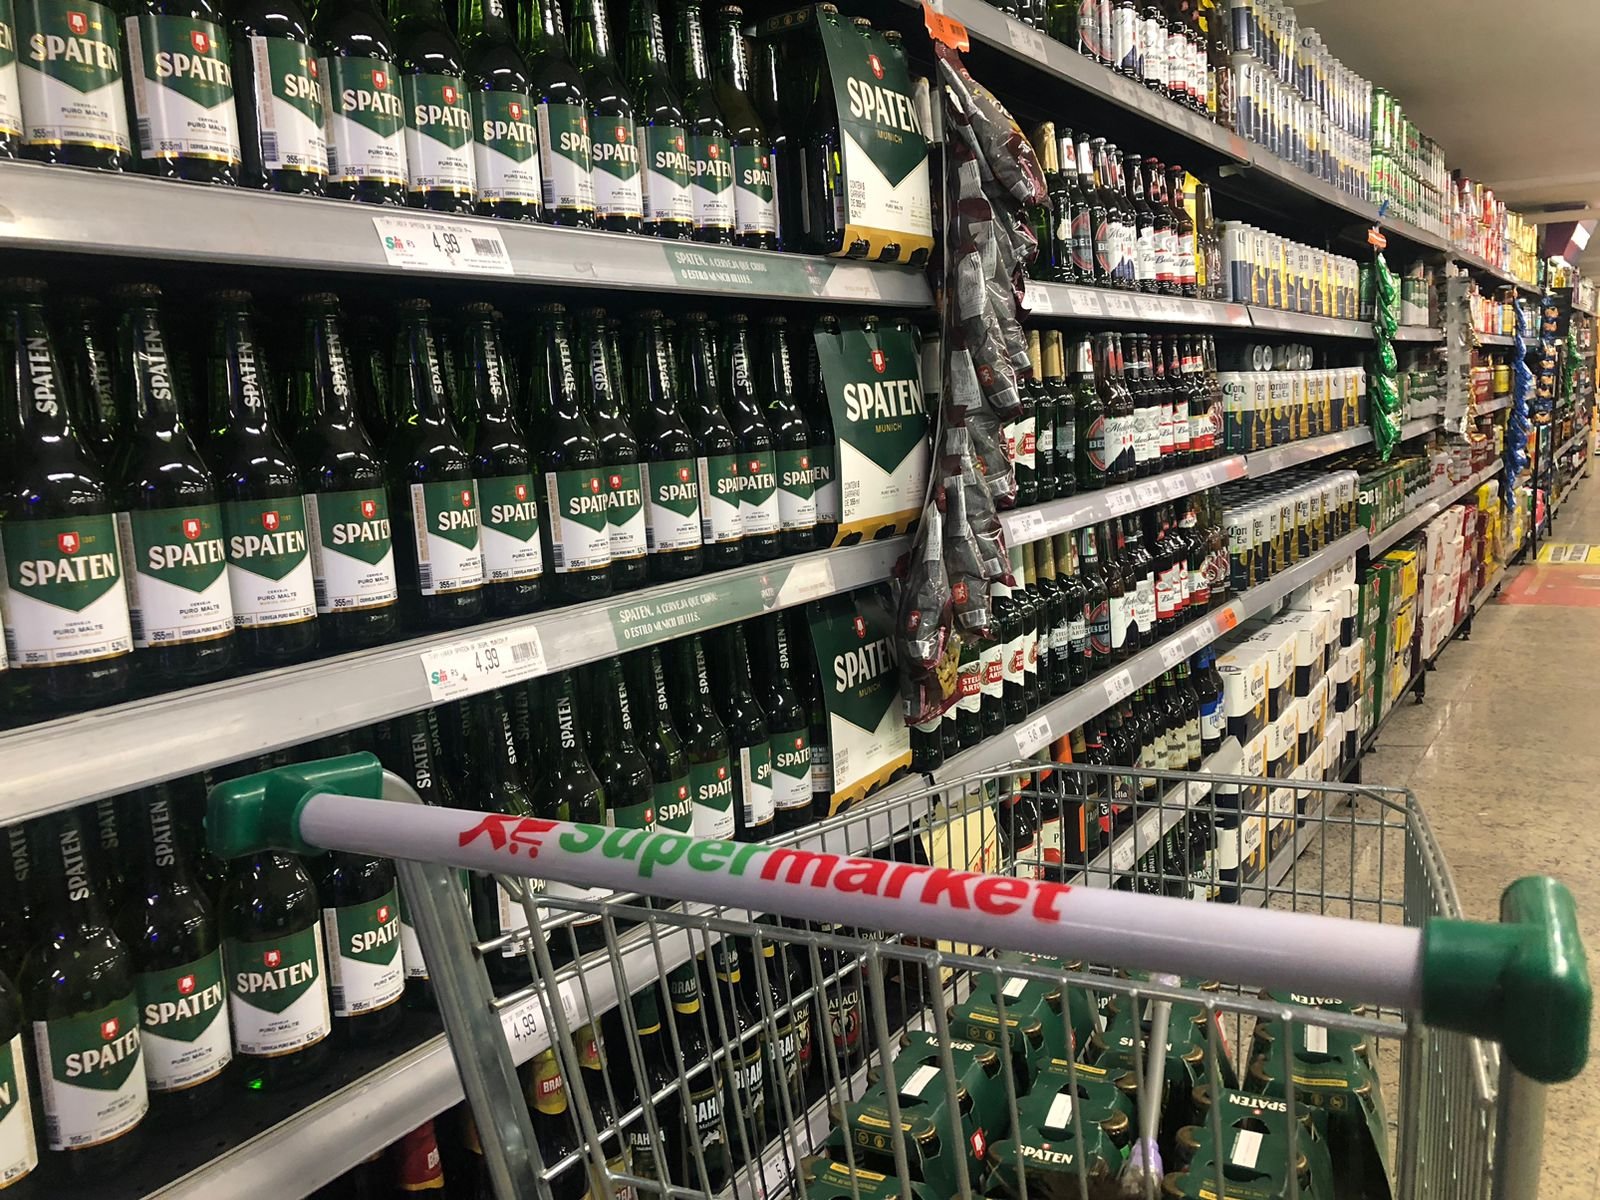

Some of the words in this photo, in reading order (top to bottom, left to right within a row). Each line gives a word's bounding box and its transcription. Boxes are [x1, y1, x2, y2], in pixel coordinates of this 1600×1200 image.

[30, 33, 118, 73] SPATEN
[154, 52, 233, 88] SPATEN
[284, 73, 321, 104] SPAT
[847, 77, 921, 135] SPATEN
[432, 231, 461, 256] 4,99
[26, 337, 58, 418] SPATEN
[143, 330, 172, 401] SPATEN
[237, 342, 261, 409] SPATEN
[327, 334, 348, 397] SPATEN
[426, 336, 444, 396] SPATEN
[485, 341, 503, 399] SPATEN
[559, 339, 577, 392] SPATEN
[591, 340, 608, 391] SPATEN
[704, 341, 716, 388] SPATEN
[732, 342, 750, 387] SPATEN
[843, 379, 924, 422] SPATEN
[875, 423, 902, 433] MUNICH
[230, 530, 305, 558] SPATEN
[19, 553, 116, 587] SPATEN
[179, 607, 199, 615] PURO
[278, 591, 297, 599] MALTE
[656, 605, 662, 615] A
[662, 598, 688, 613] CERVEJA
[688, 595, 700, 608] QUE
[152, 631, 176, 641] 355ml
[624, 629, 630, 639] O
[631, 623, 653, 638] ESTILO
[778, 629, 790, 670] SPATEN
[475, 647, 500, 674] 4,99
[696, 650, 710, 695] SPATEN
[834, 636, 899, 693] SPATEN
[618, 681, 633, 731] SPATEN
[655, 663, 669, 712] SPATEN
[502, 711, 518, 765] SPATEN
[556, 696, 576, 749] SPATEN
[410, 732, 432, 789] SPATEN
[149, 800, 175, 868] SPATEN
[60, 829, 90, 902] SPATEN
[236, 959, 313, 993] SPATEN
[145, 982, 222, 1026] SPATEN
[1291, 992, 1342, 1006] SPATEN
[513, 1012, 537, 1042] 4,99
[1229, 1093, 1287, 1113] SPATEN
